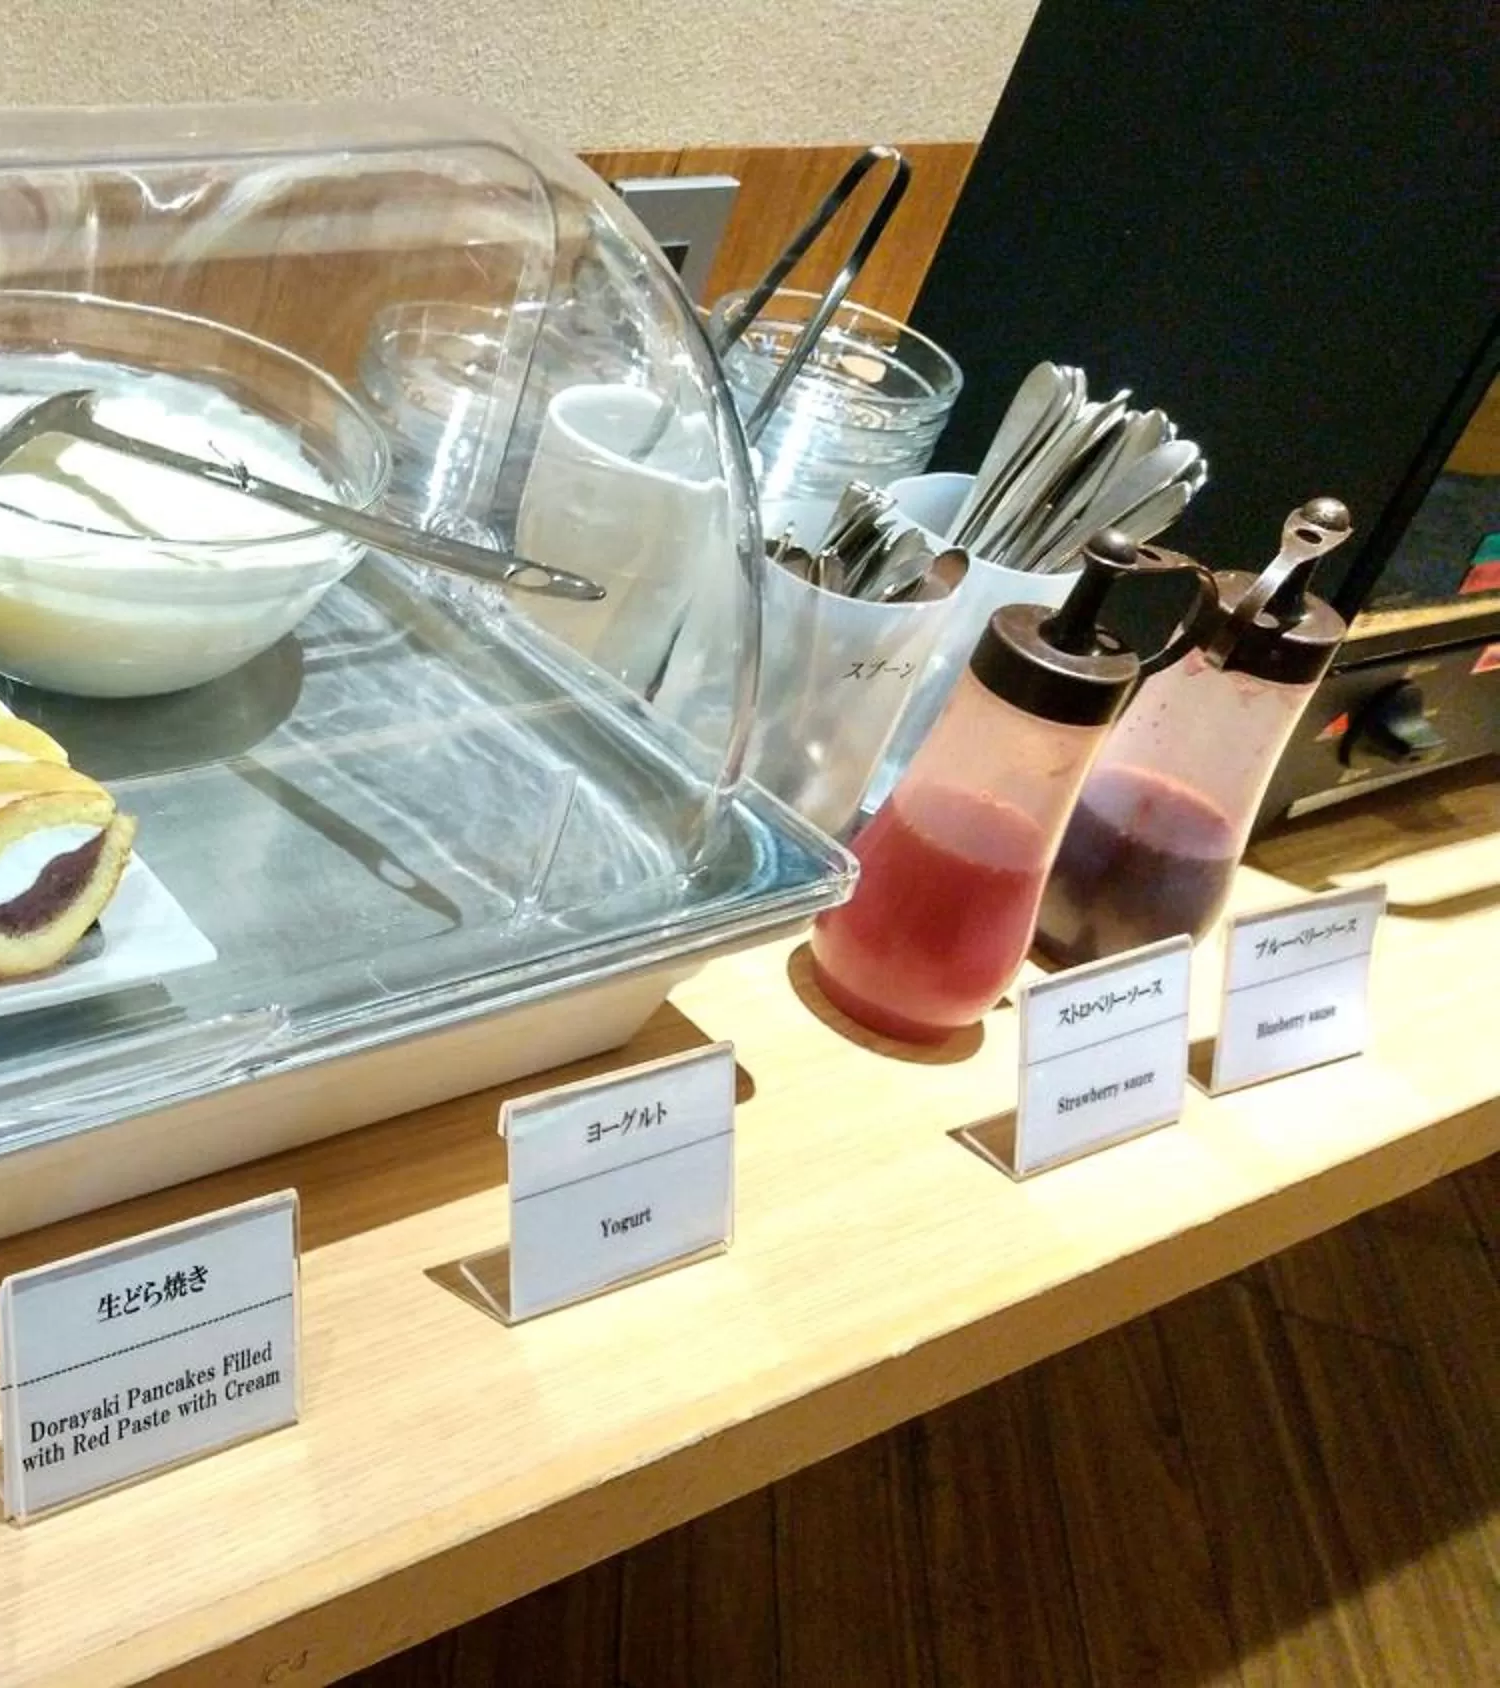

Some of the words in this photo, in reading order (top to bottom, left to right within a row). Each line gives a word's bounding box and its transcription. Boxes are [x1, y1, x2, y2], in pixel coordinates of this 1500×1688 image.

[1058, 978, 1163, 1026] ストロベリーソース
[1057, 1083, 1120, 1114] Strawberry
[1124, 1071, 1155, 1091] sauce
[586, 1101, 668, 1143] ヨーグルト
[600, 1208, 653, 1238] Yogurt
[97, 1264, 209, 1323] 生どら焼き
[30, 1394, 120, 1443] Dorayaki
[127, 1363, 216, 1410] Pancakes
[222, 1341, 273, 1376] Filled
[22, 1441, 65, 1473] with
[73, 1427, 110, 1456] Red
[116, 1408, 171, 1441] Paste
[177, 1389, 218, 1418] with
[224, 1369, 281, 1401] Cream
